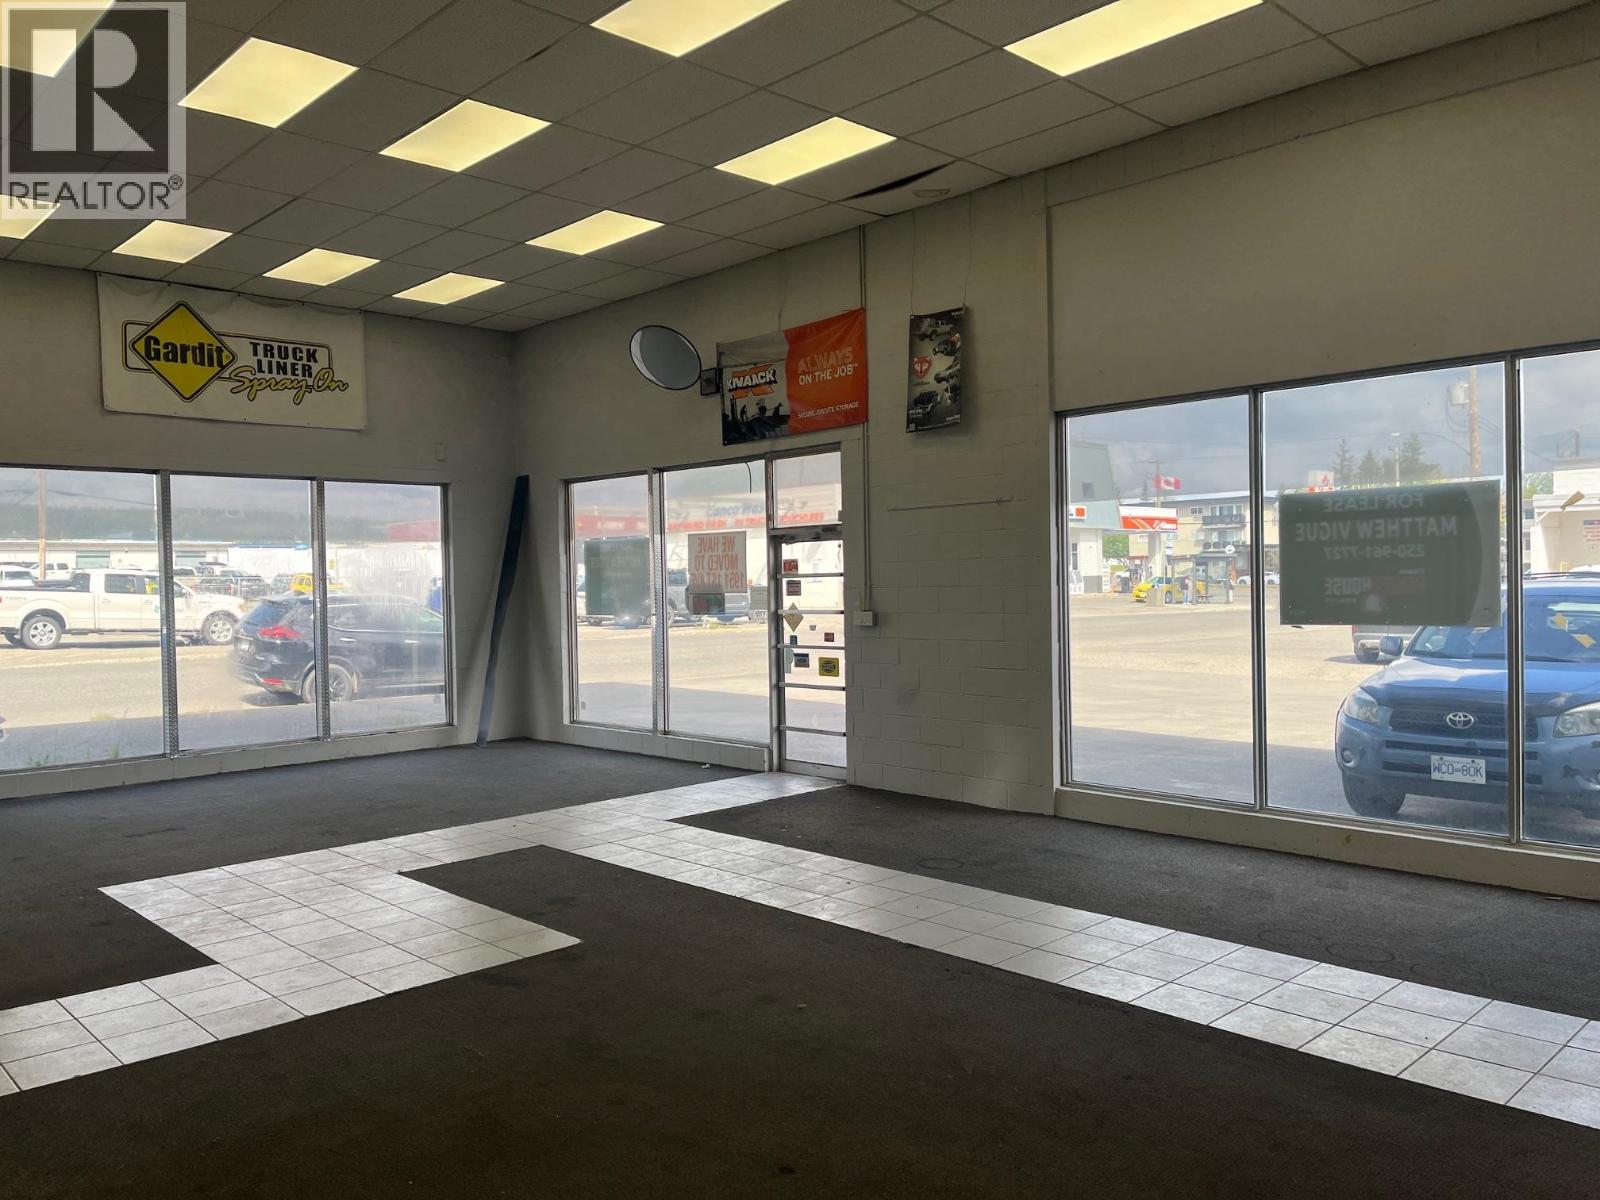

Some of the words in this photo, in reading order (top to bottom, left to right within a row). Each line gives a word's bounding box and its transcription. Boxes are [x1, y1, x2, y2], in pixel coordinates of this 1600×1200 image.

[143, 335, 226, 369] Gardit
[249, 341, 319, 364] TRUCK
[797, 346, 853, 374] ALWAYS
[256, 358, 314, 378] LINER
[727, 367, 777, 391] KNAACK
[798, 373, 812, 386] ON
[814, 368, 833, 382] THE
[836, 402, 860, 411] STORAGE
